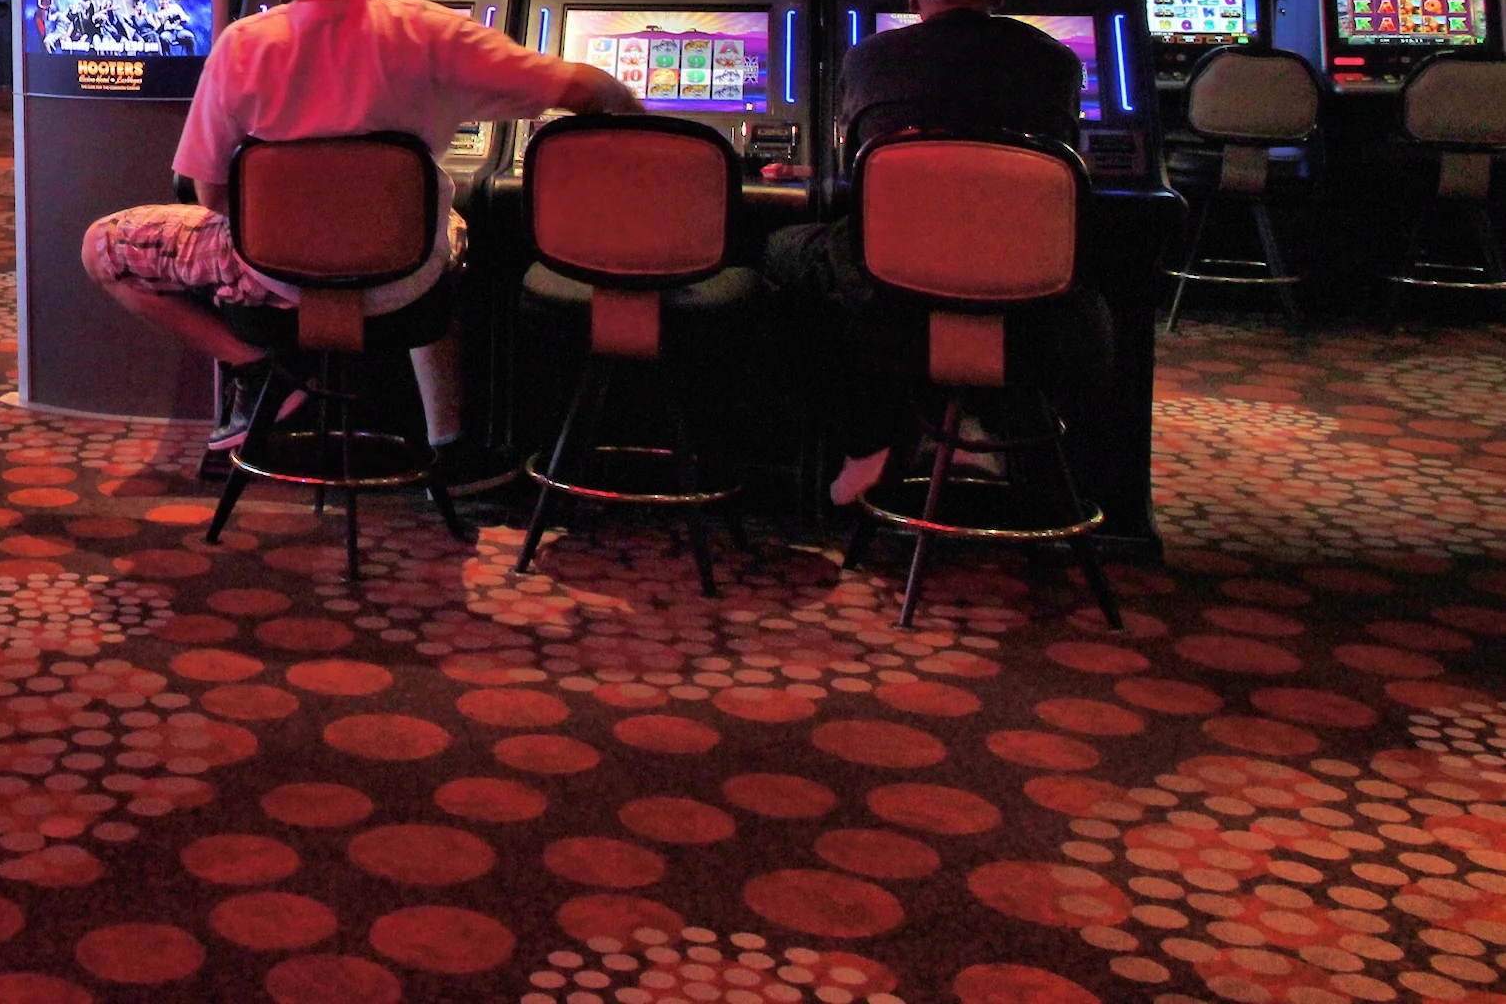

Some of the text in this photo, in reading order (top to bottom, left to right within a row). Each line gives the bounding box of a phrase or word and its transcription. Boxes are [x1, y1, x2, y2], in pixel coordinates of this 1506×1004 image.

[1353, 0, 1373, 13] K
[1377, 0, 1395, 13] A
[1447, 0, 1467, 13] K
[1355, 17, 1373, 31] K
[1378, 17, 1397, 31] A
[1448, 17, 1468, 31] K
[78, 60, 144, 76] HOOTERS
[621, 69, 642, 82] 10
